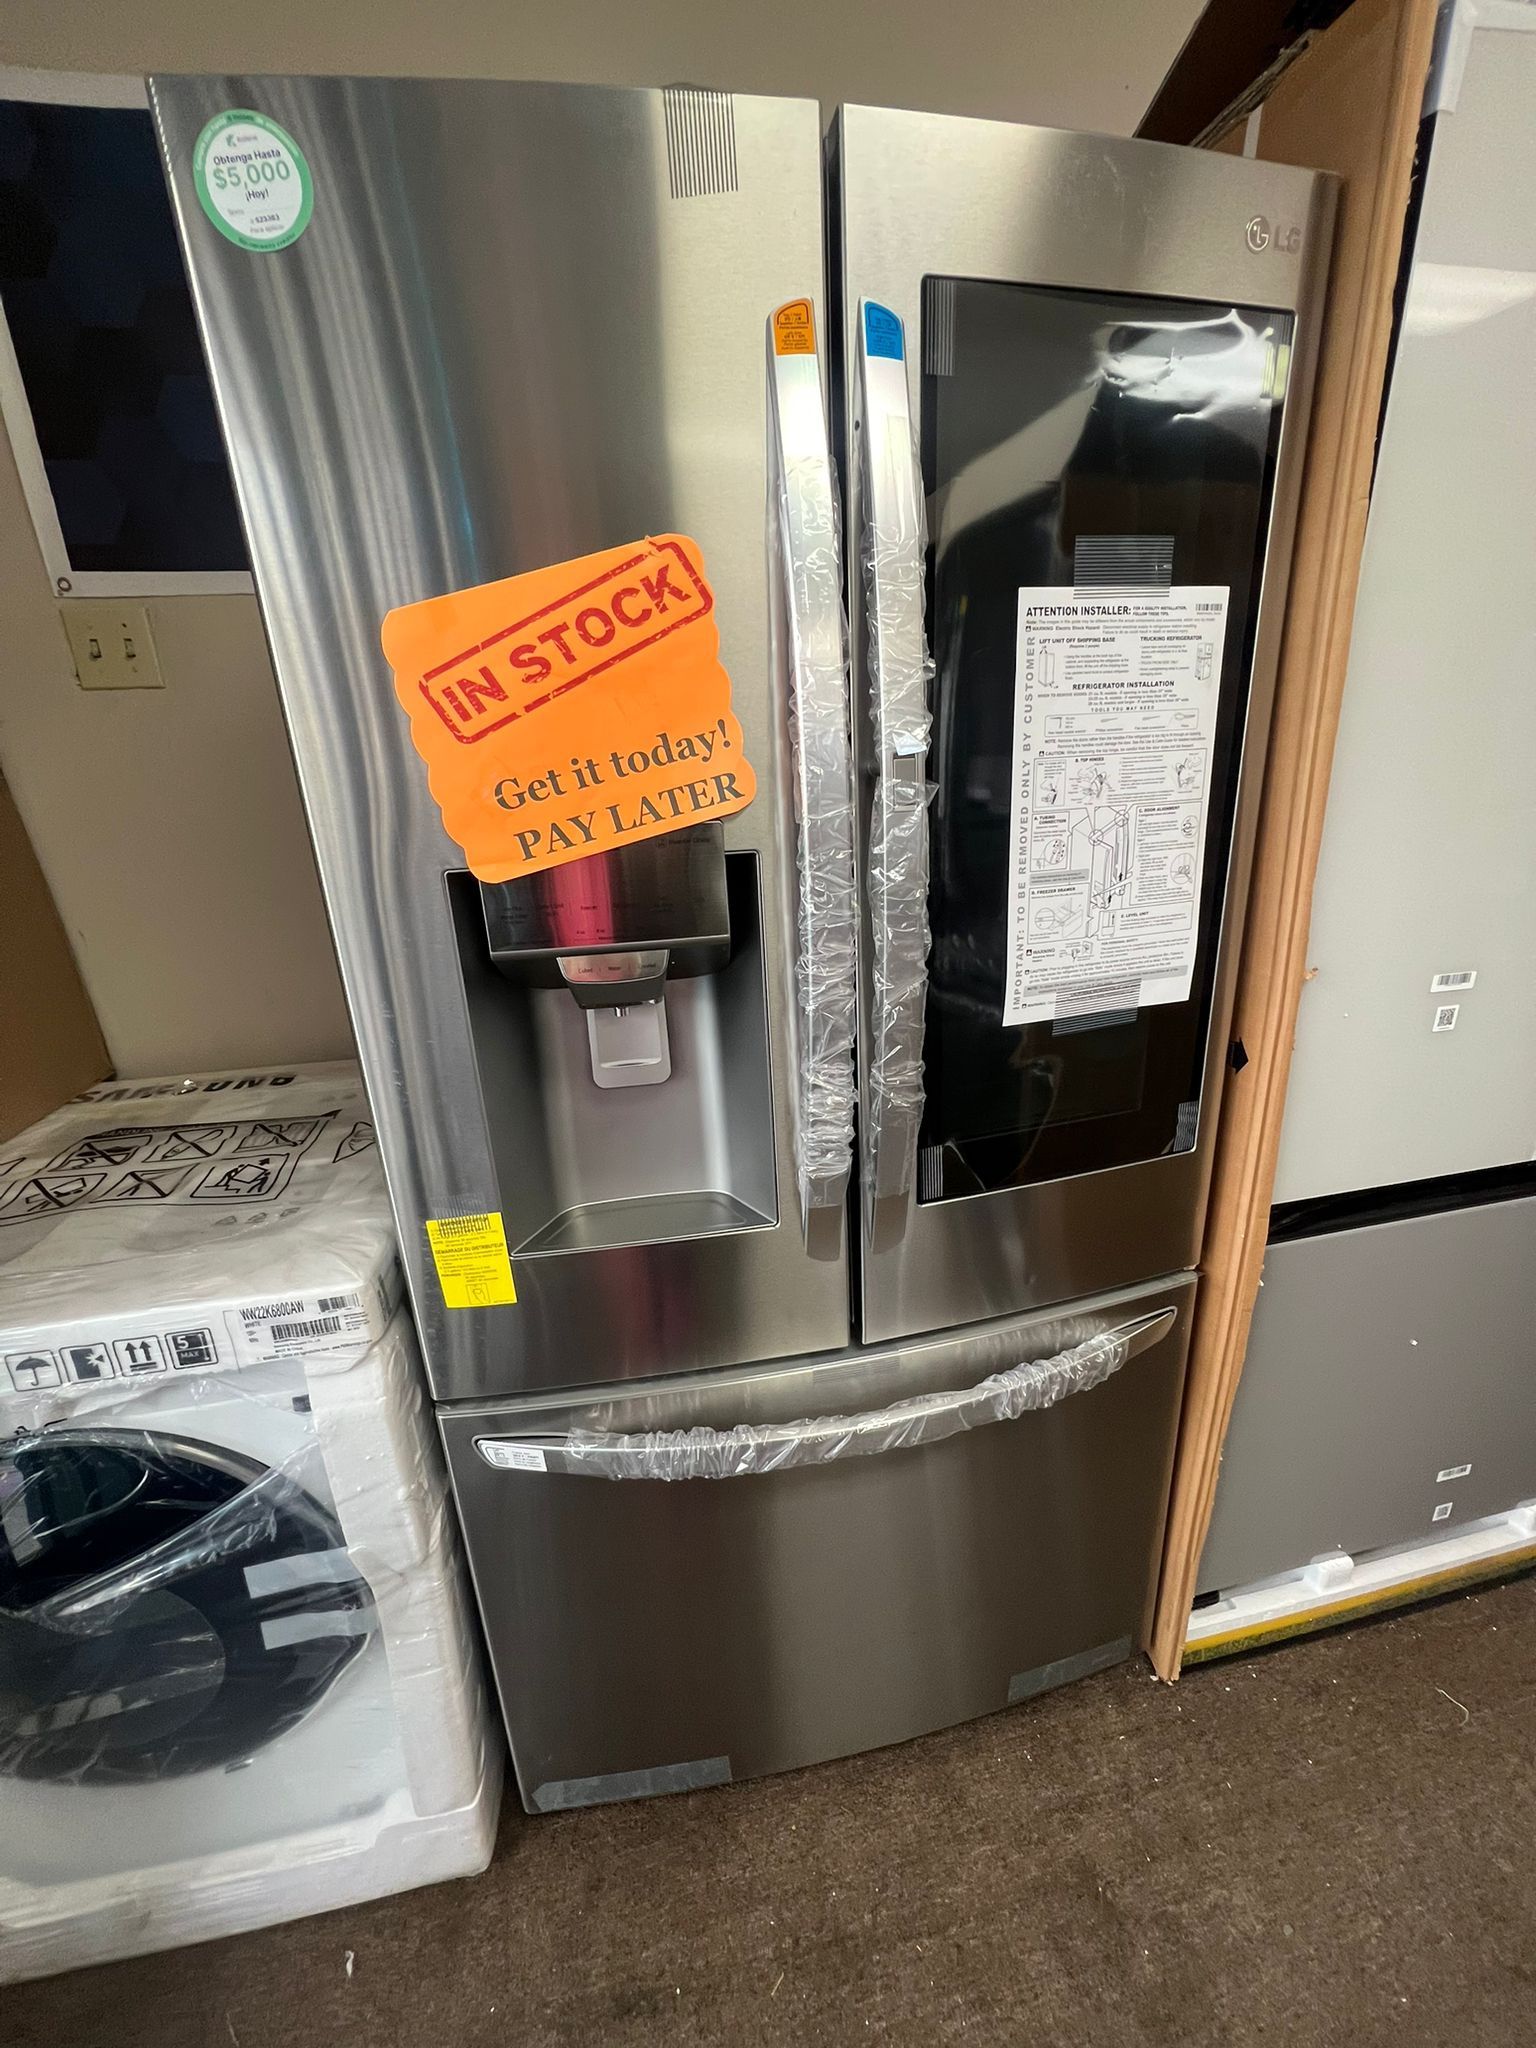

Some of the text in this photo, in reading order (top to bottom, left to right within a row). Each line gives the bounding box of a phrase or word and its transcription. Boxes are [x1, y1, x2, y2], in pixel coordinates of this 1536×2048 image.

[213, 149, 281, 166] Obtenga Hasta
[213, 160, 290, 190] $5,000
[245, 187, 269, 202] ¡Hoy!
[1274, 225, 1301, 255] LG
[1026, 605, 1131, 617] ATTENTION INSTALLER:
[441, 563, 691, 722] IN STOCK
[1072, 682, 1125, 690] REFRIGERATOR
[494, 718, 732, 811] Get it today!
[513, 772, 745, 862] PAY LATER
[1012, 636, 1035, 1010] IMPORTANT: TO BE REMOVED ONLY BY CUSTOMER
[240, 1300, 305, 1321] WW22K6800AW
[177, 1335, 189, 1349] 5
[180, 1351, 199, 1359] MAX
